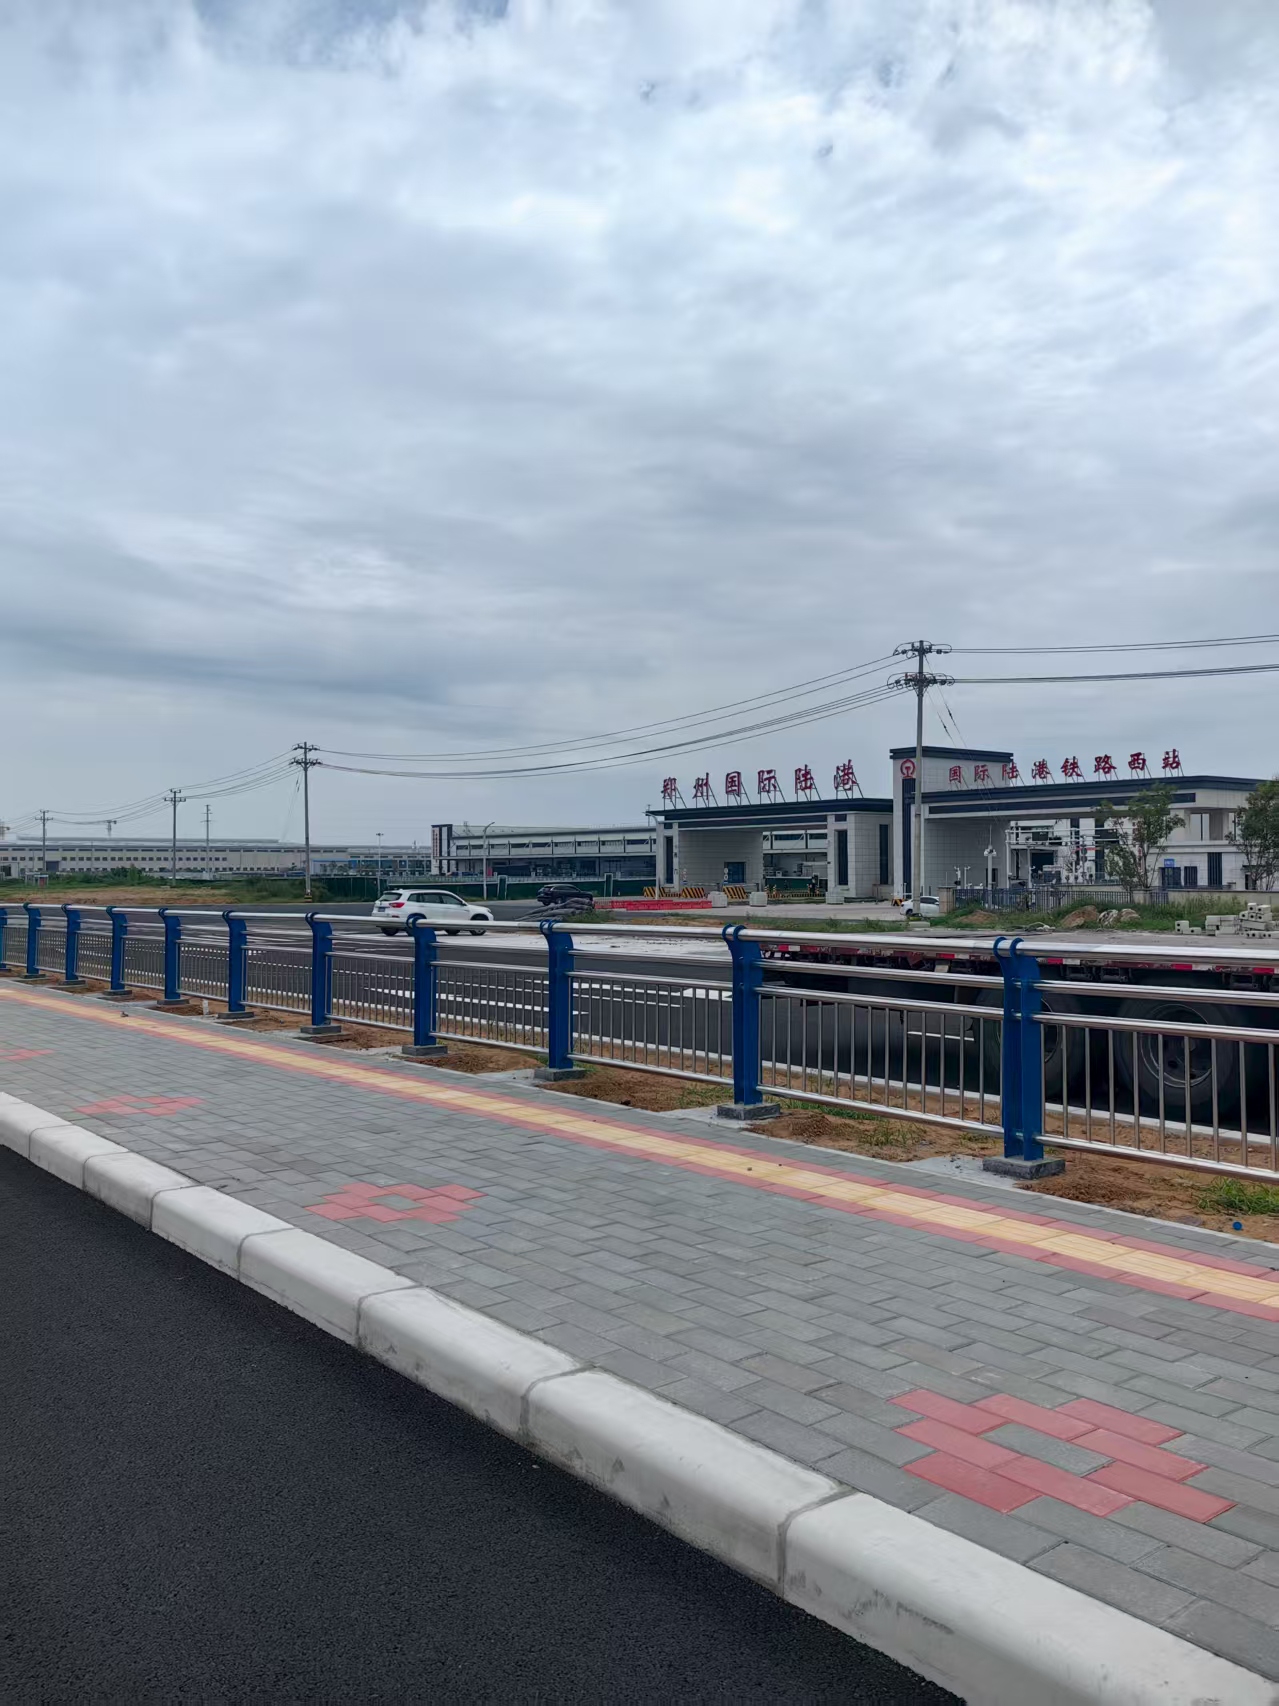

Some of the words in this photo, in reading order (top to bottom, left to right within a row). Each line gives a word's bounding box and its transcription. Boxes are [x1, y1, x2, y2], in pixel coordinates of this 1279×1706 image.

[661, 759, 857, 802] 郑州国际陆港
[948, 748, 1182, 784] 国际陆港铁路西站
